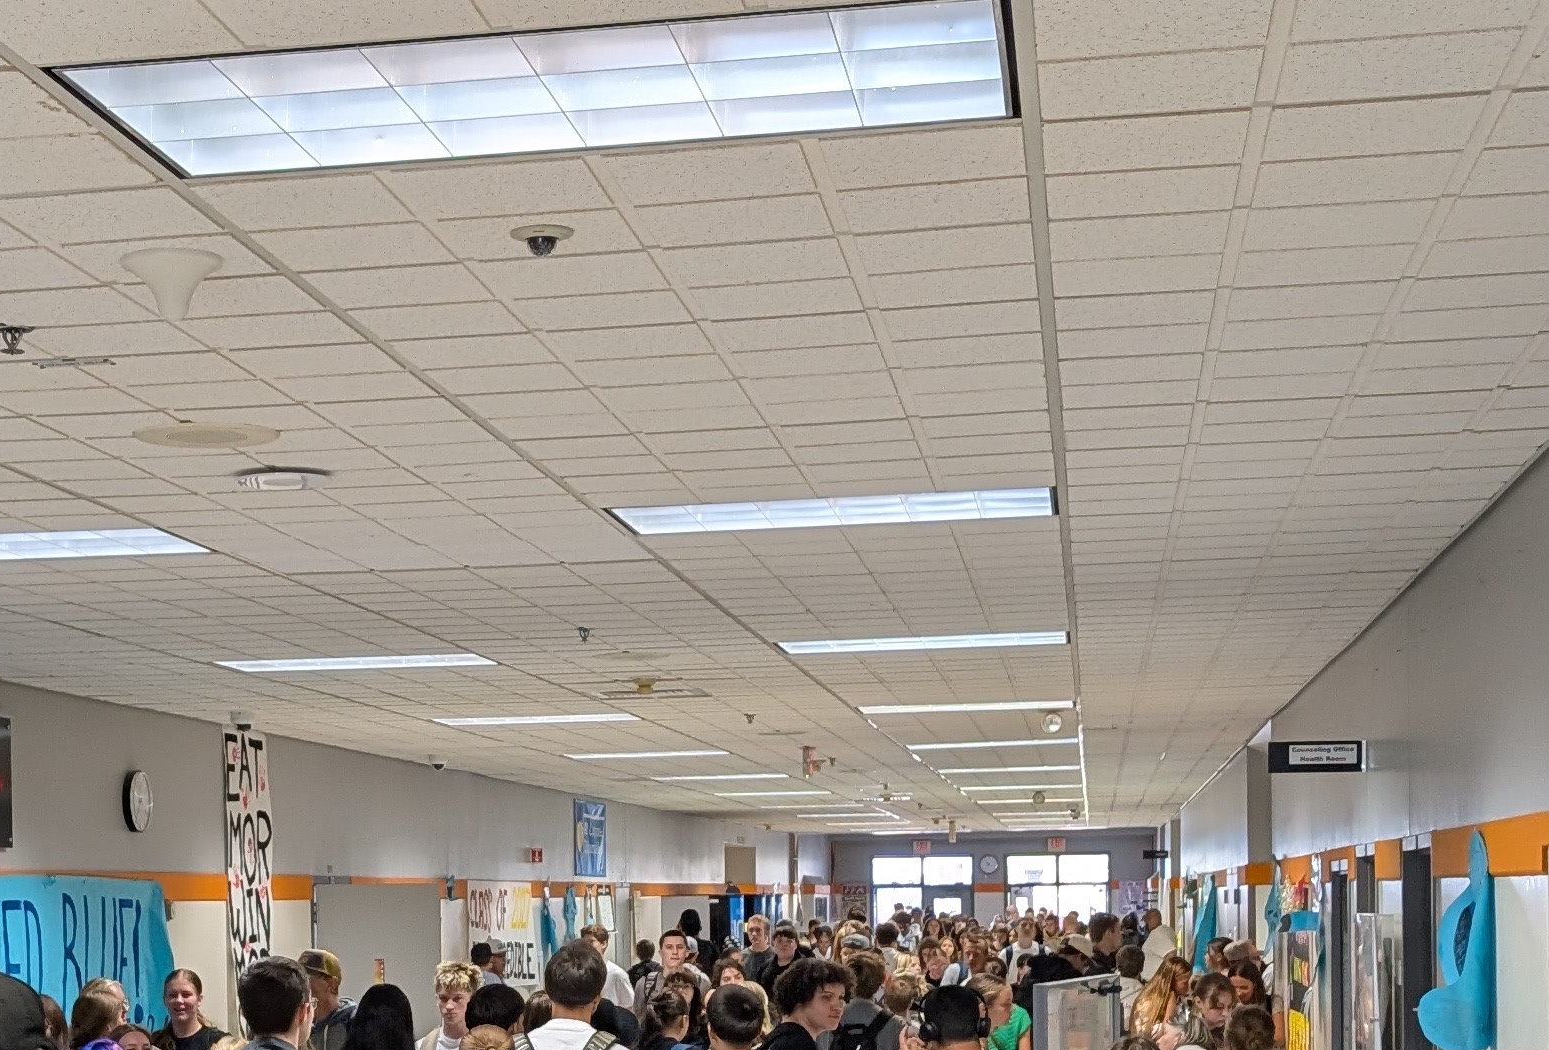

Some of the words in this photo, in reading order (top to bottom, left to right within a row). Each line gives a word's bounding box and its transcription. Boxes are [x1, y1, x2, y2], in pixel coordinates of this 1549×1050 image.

[224, 732, 264, 802] EAT
[228, 809, 272, 887] MOR
[227, 880, 271, 952] WIN
[496, 888, 508, 931] OF
